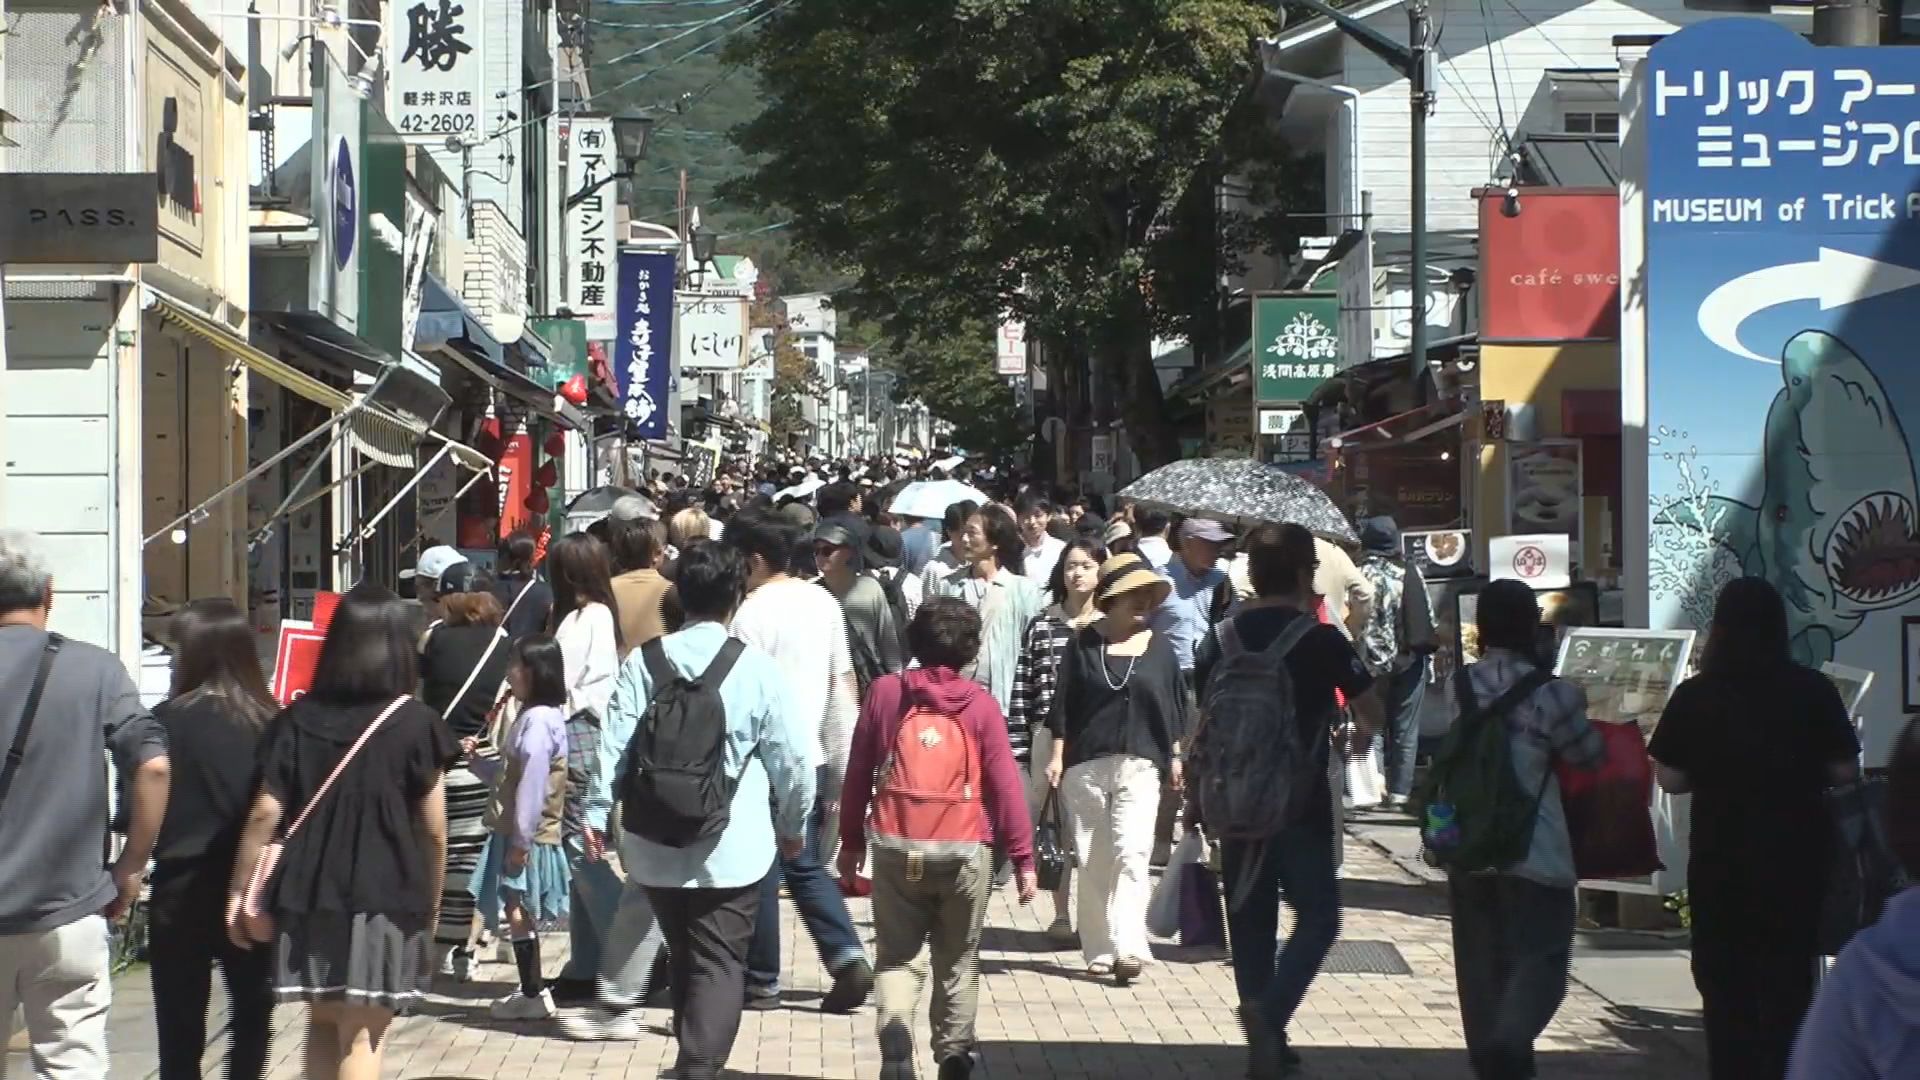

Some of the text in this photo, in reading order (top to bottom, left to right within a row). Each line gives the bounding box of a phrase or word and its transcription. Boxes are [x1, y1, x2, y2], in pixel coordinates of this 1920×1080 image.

[401, 0, 473, 72] 勝
[403, 91, 472, 106] 軽井沢店
[400, 113, 475, 132] 42-2602
[1653, 198, 1762, 222] MUSEUM
[1778, 198, 1805, 222] of
[1822, 193, 1896, 220] Trick
[1510, 268, 1562, 285] café
[690, 332, 743, 358] にし川
